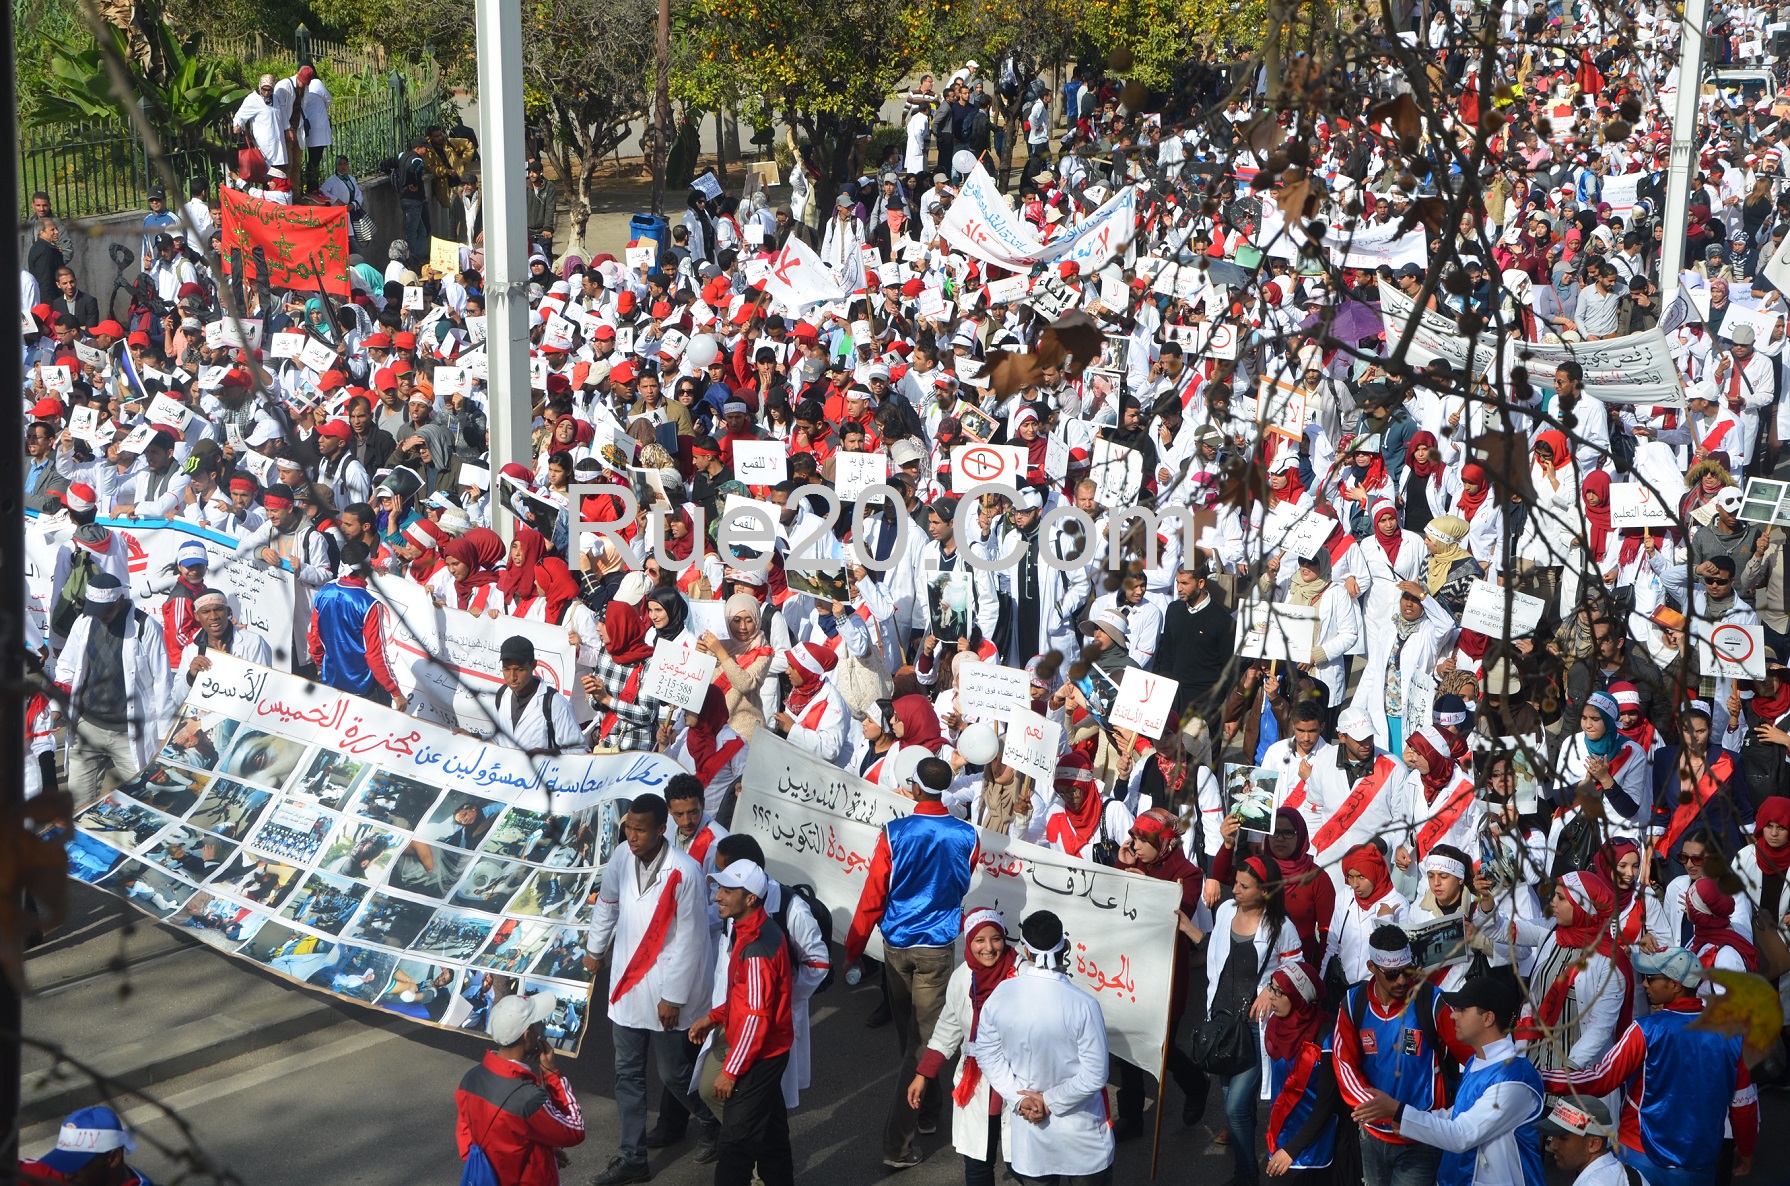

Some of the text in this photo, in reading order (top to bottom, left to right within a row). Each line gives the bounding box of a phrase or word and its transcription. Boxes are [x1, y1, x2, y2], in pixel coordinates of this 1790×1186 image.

[741, 456, 778, 475] لا للقمع
[658, 658, 706, 682] للمرسومين
[679, 650, 690, 666] لا
[658, 674, 693, 695] 2-15-588
[970, 669, 998, 680] المرسومين
[655, 685, 690, 705] 2-15-589
[1139, 678, 1156, 703] لا
[201, 668, 269, 705] الأسود
[257, 698, 350, 731] الخميس
[339, 716, 422, 758] مجزرة
[414, 745, 443, 765] عن
[442, 745, 549, 793] المسؤولين
[1114, 704, 1164, 733] لقمع الأساتذة
[1024, 724, 1044, 744] نعم
[1004, 741, 1033, 765] المرسومين
[1026, 859, 1119, 910] علاقة
[1123, 881, 1138, 922] ما
[1076, 942, 1137, 1004] بالجودة
